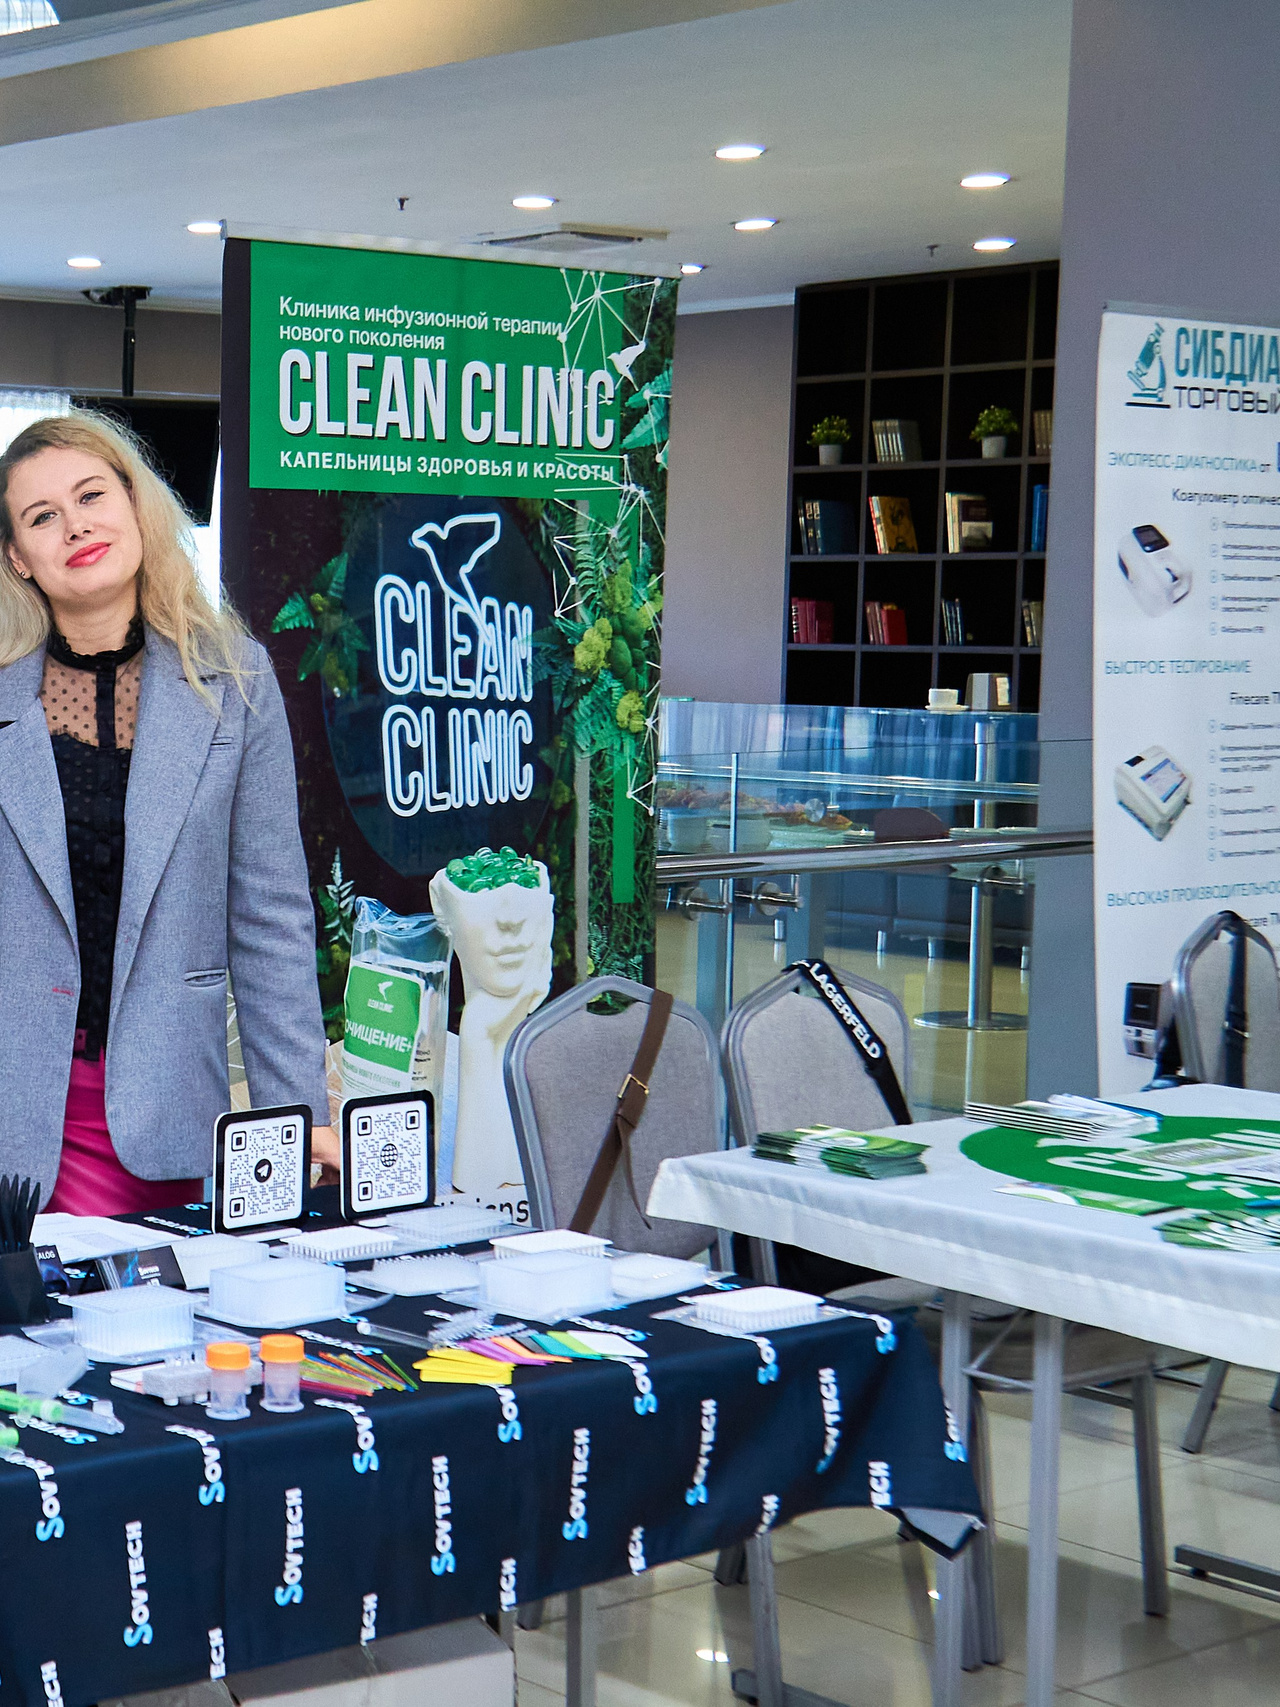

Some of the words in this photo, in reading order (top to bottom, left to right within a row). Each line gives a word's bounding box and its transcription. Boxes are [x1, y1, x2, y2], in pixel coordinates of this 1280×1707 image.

[279, 296, 360, 322] Клиника
[364, 305, 488, 332] инфузионной
[492, 317, 562, 338] терапии
[279, 326, 344, 344] нового
[349, 331, 445, 351] поколения
[278, 347, 447, 442] CLEAN
[460, 359, 616, 451] CLINIC
[279, 450, 413, 474] КАПЕЛЬНИЦЫ
[417, 456, 512, 478] ЗДОРОВЬЯ
[517, 461, 530, 476] И
[532, 462, 615, 482] КРАСОТЫ
[374, 574, 533, 702] CLEAN
[1105, 660, 1166, 675] БЫСТРОЕ
[381, 704, 534, 818] CLINIC
[1106, 889, 1169, 907] ВЫСОКАЯ
[809, 962, 882, 1060] LAGERFELD
[36, 1250, 56, 1260] ALOG
[430, 1455, 456, 1576] SOVTECH
[562, 1427, 590, 1541] SOVTECH
[124, 1520, 153, 1647] SOVTECH
[275, 1487, 303, 1607] SOVTECH
